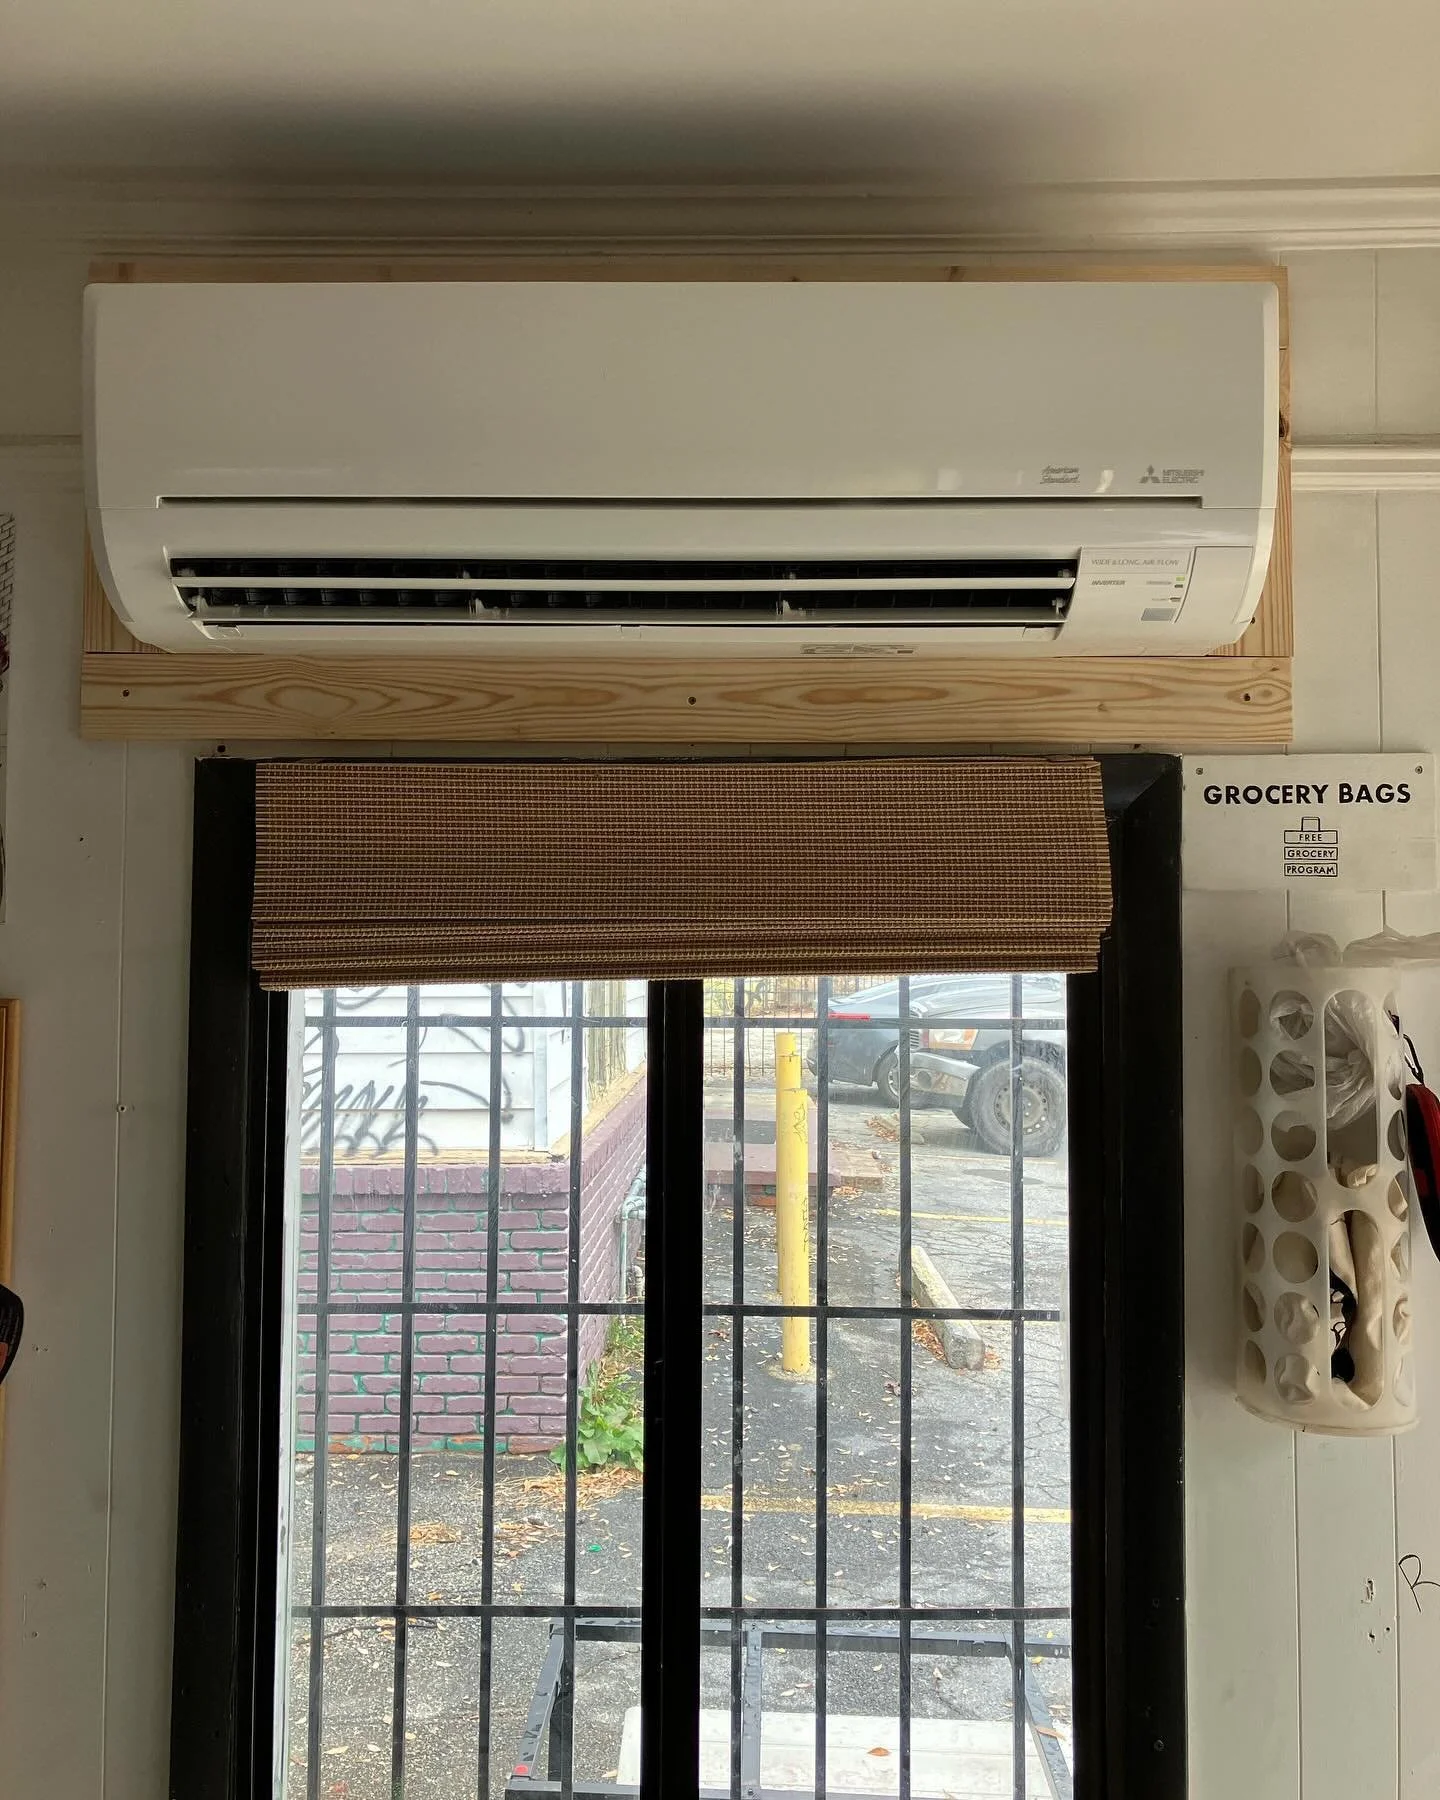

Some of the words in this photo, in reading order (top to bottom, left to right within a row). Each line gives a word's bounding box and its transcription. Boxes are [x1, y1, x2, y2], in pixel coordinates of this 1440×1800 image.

[1203, 784, 1329, 805] GROCERY
[1338, 782, 1411, 804] BAGS
[1299, 833, 1323, 842] FREE
[1287, 849, 1335, 859] GROCERY
[1286, 865, 1336, 875] PROGRAM
